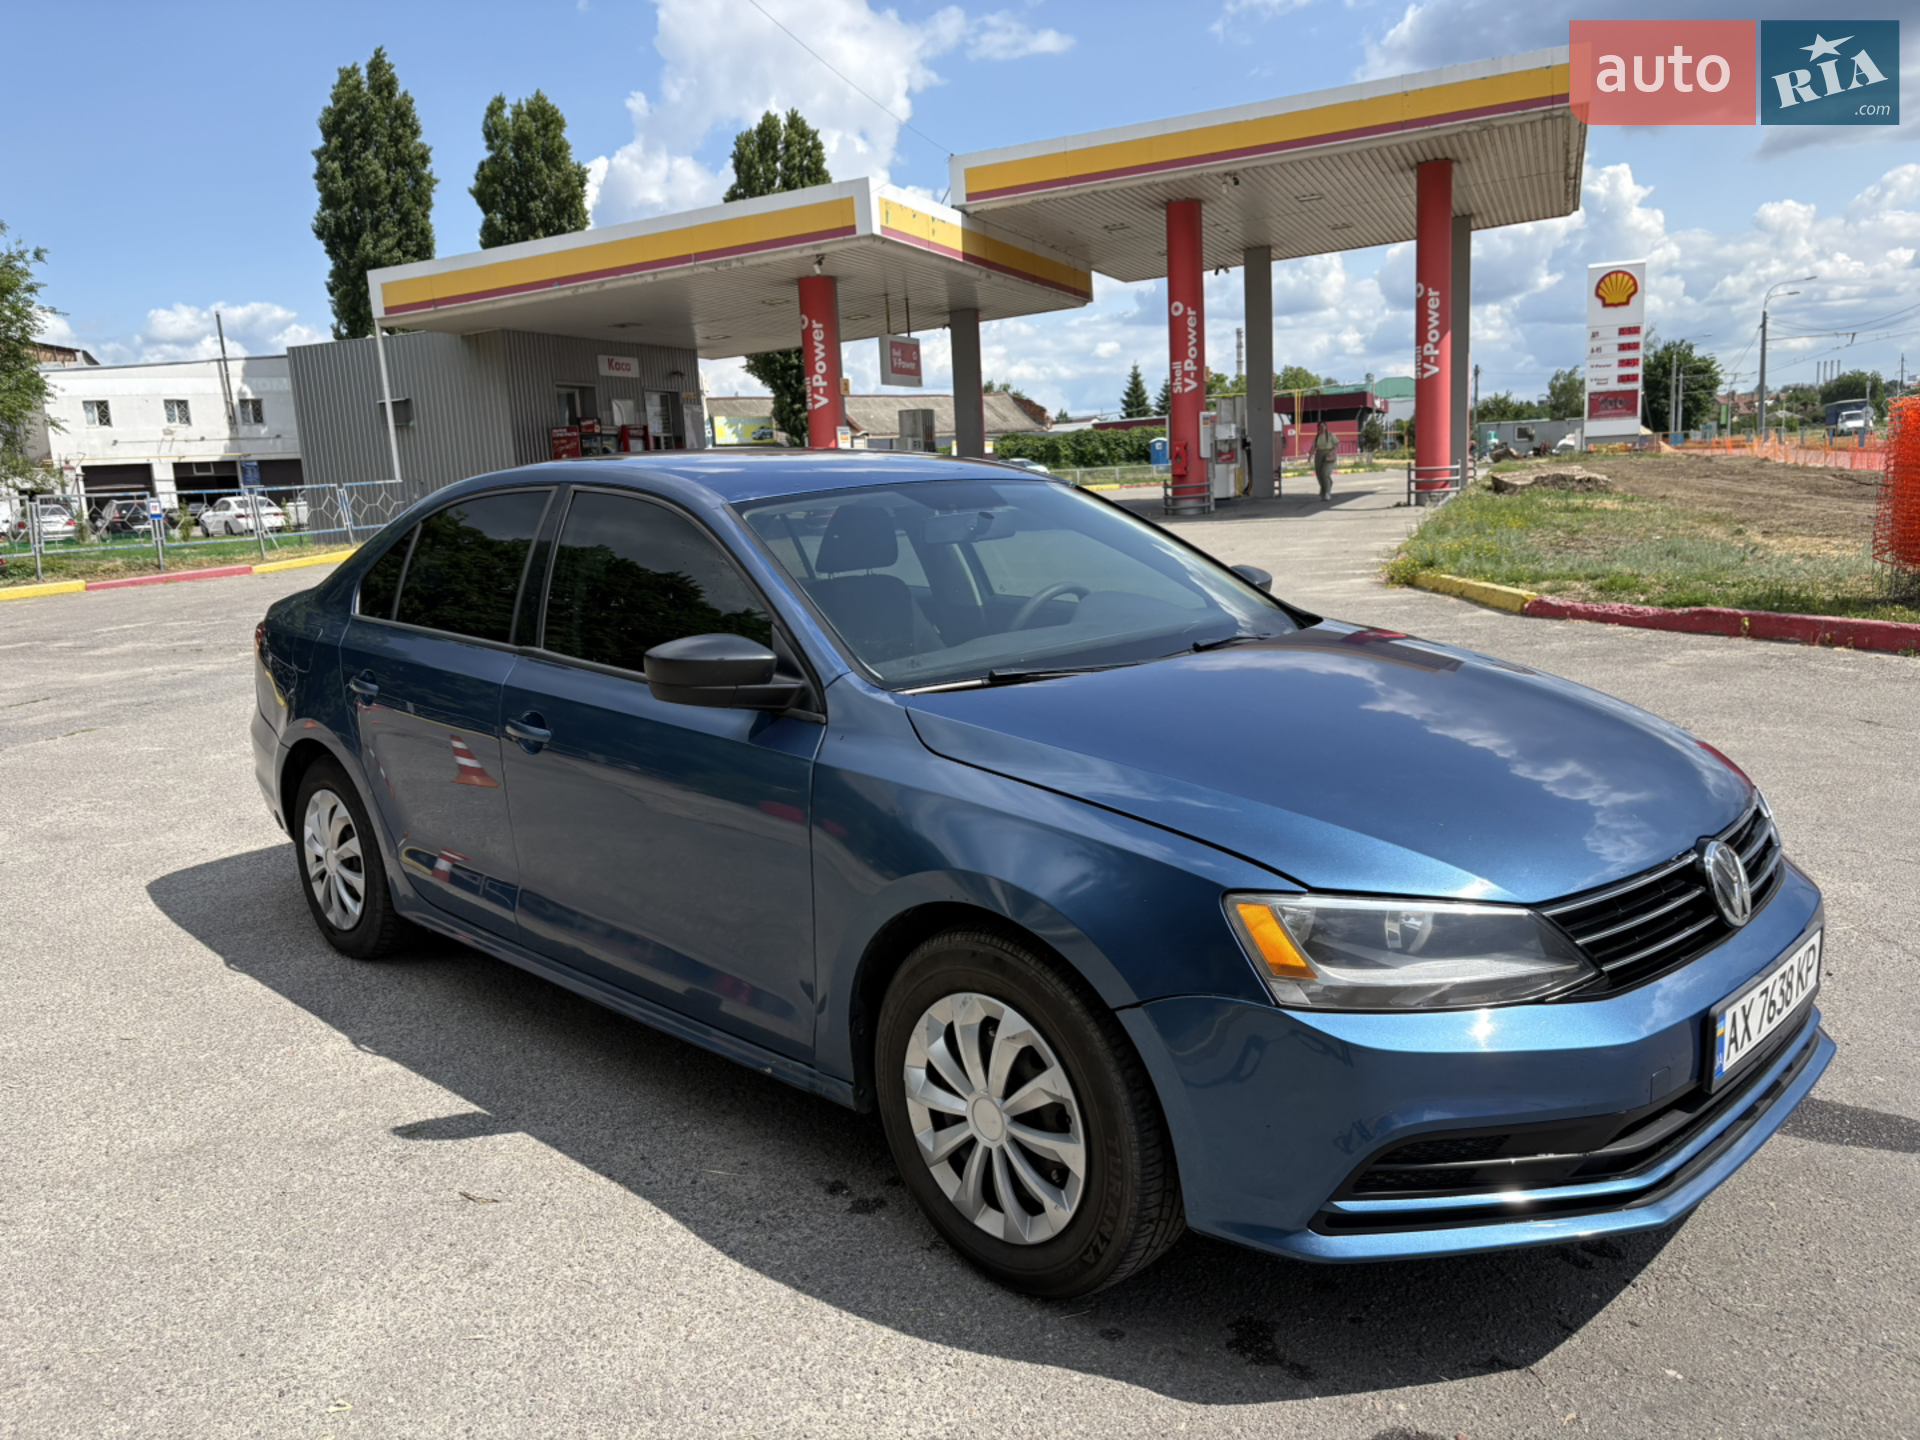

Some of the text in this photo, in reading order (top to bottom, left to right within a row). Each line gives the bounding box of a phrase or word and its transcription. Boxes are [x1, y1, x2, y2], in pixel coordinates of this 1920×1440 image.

[607, 357, 632, 372] Каса
[810, 318, 830, 410] V-Power
[1171, 361, 1182, 394] Shell
[1184, 306, 1198, 393] V-Power
[1423, 287, 1440, 380] V-Power
[1725, 943, 1817, 1062] AX 7638 KP
